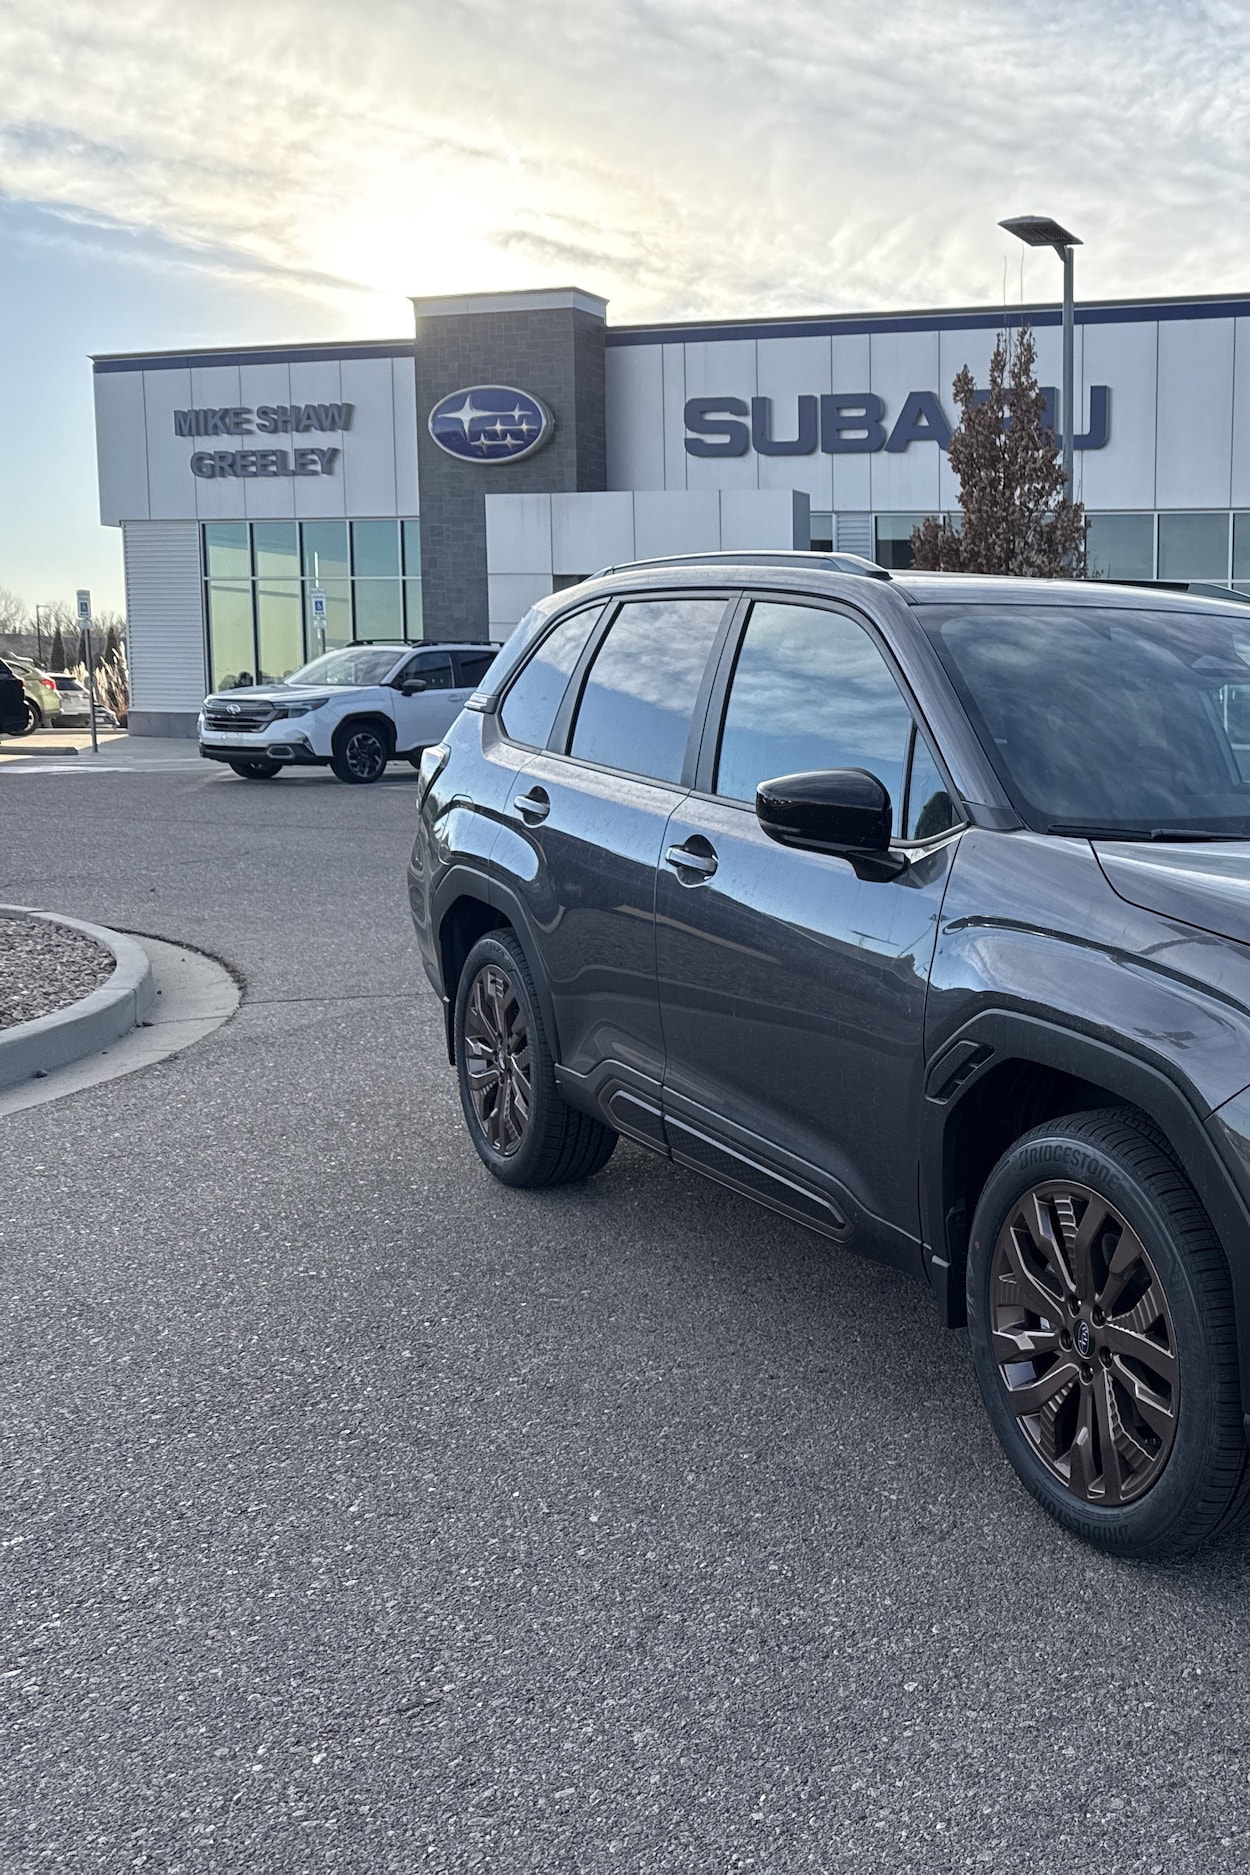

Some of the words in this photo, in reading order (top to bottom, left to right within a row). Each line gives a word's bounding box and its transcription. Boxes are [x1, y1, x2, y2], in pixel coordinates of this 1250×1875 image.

[174, 407, 253, 437] MIKE
[256, 403, 355, 434] SHAW
[683, 385, 1111, 458] SUBAU
[190, 448, 340, 479] GREELEY
[1019, 1144, 1121, 1192] BRIDGESTONE
